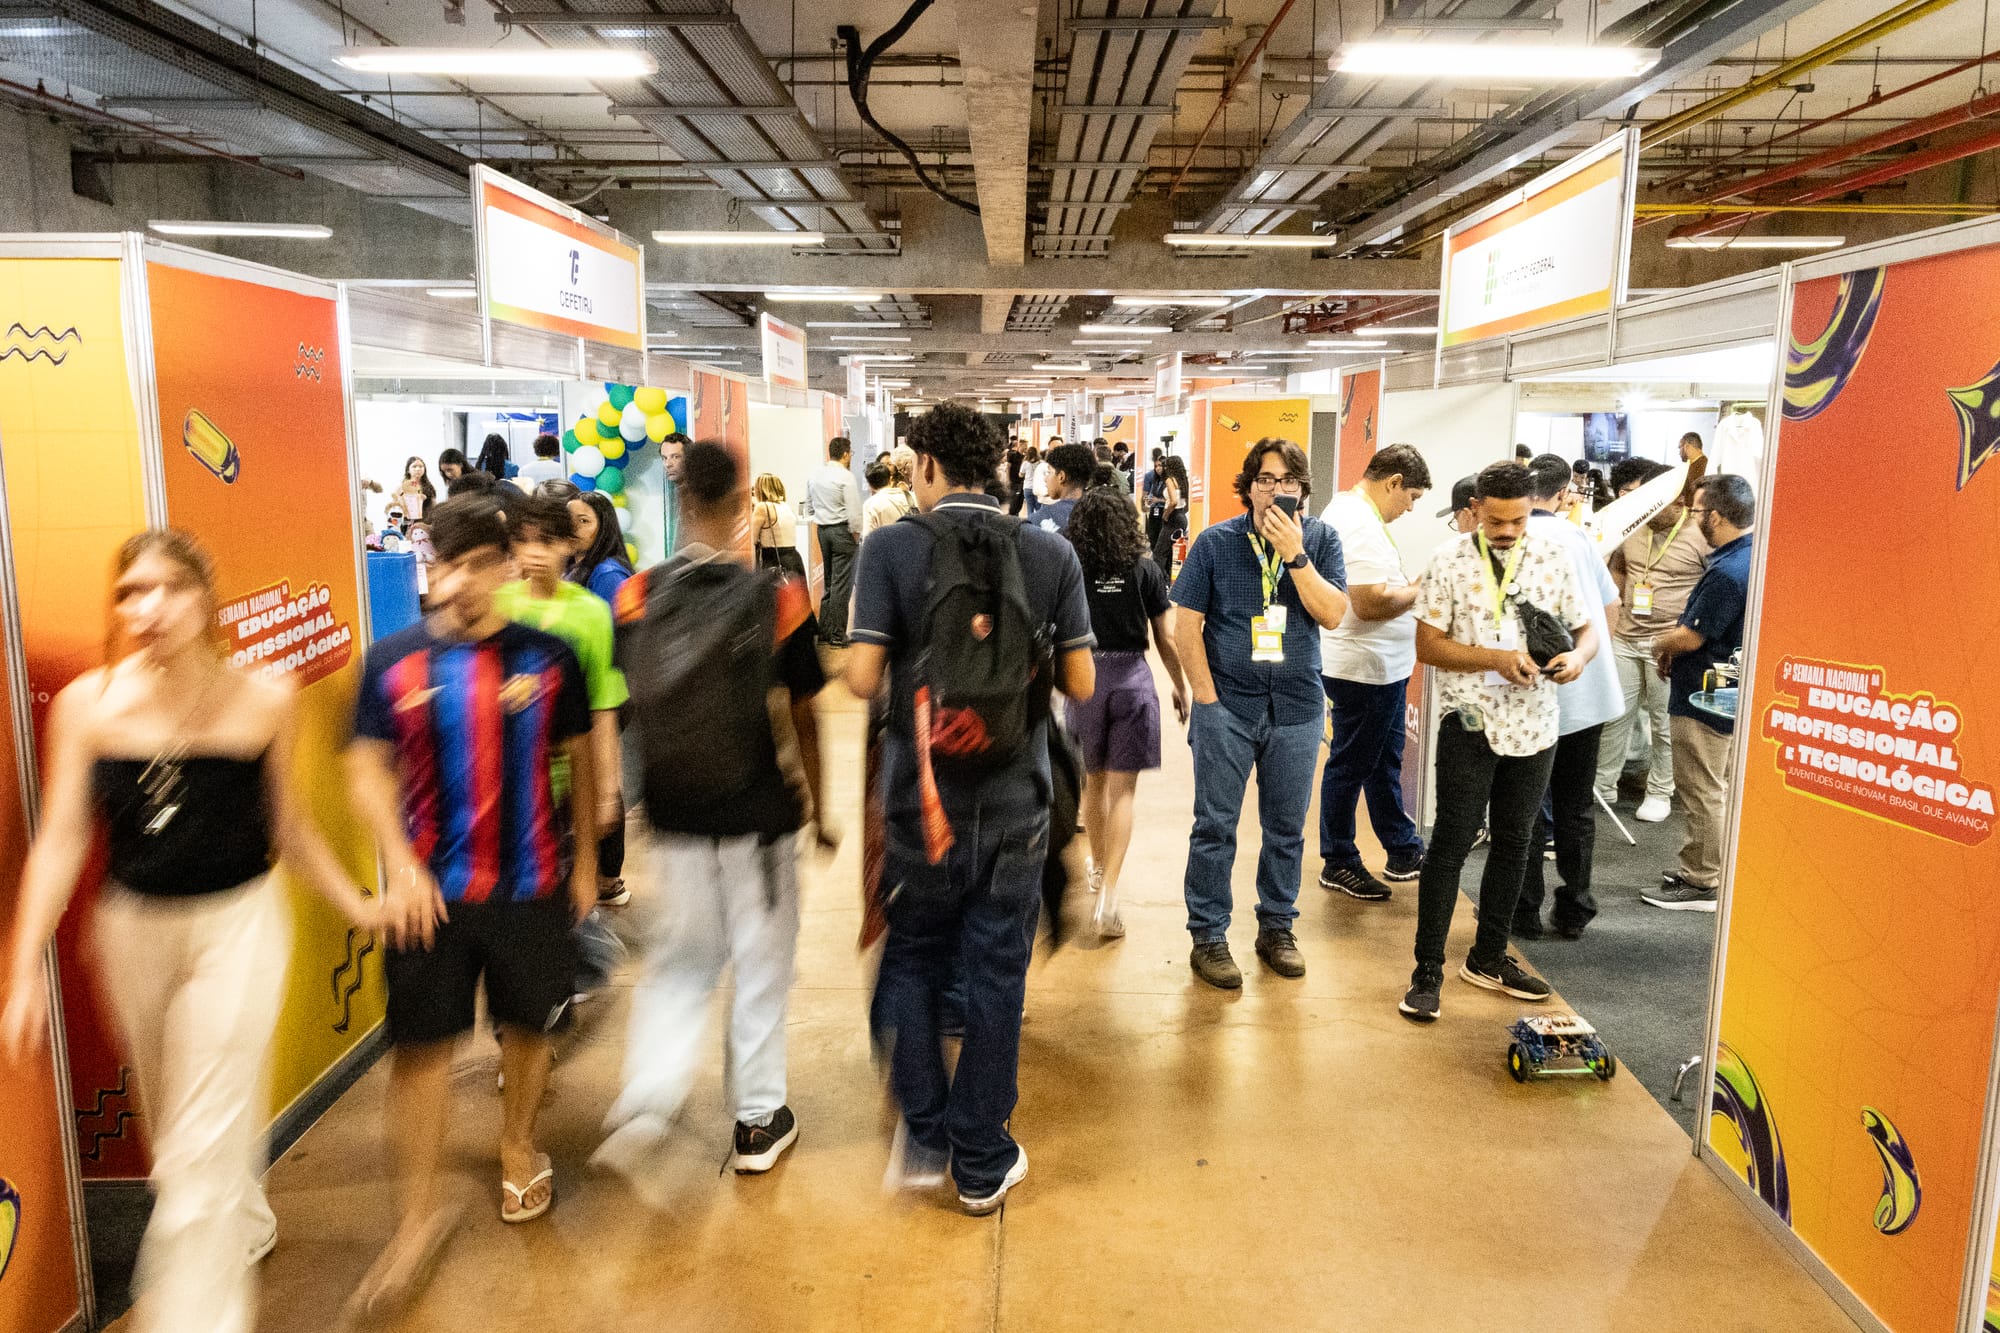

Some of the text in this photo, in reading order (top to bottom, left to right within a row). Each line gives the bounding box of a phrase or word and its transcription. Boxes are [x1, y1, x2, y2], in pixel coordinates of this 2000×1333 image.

[218, 600, 249, 627] SEMANA
[250, 587, 283, 615] NACIONAL
[237, 587, 330, 640] EDUCAÇÃO
[228, 611, 335, 670] OFISSIONAL
[1792, 663, 1825, 687] SEMANA
[1825, 668, 1869, 694] NACIONAL
[1808, 687, 1957, 733] EDUCAÇÃO
[1770, 709, 1958, 771] PROFISSIONAL
[1785, 745, 1995, 815] E TECNOLÓGICA
[1787, 766, 1989, 832] JUVENTUDES QUE INOVAM, BRASIL QUE AVANÇA
